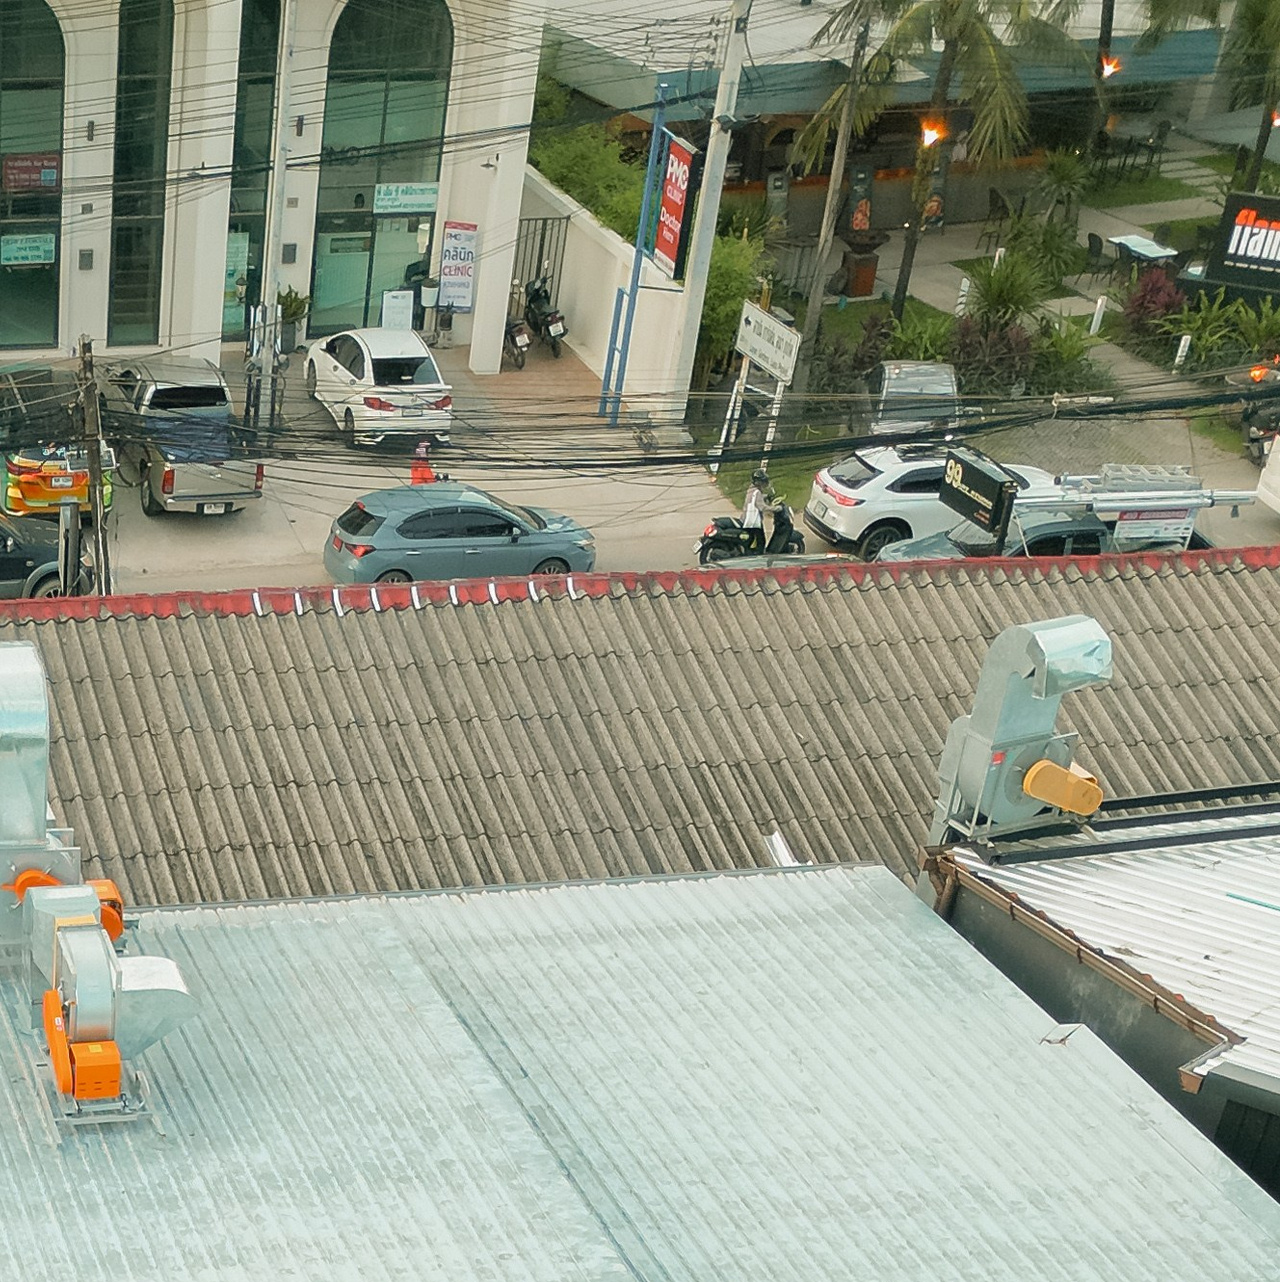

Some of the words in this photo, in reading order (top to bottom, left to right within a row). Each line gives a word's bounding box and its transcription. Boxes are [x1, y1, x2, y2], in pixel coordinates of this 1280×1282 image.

[666, 153, 689, 191] PMC
[660, 206, 681, 232] Doctor
[443, 265, 472, 278] CLINIC
[945, 459, 963, 489] 99
